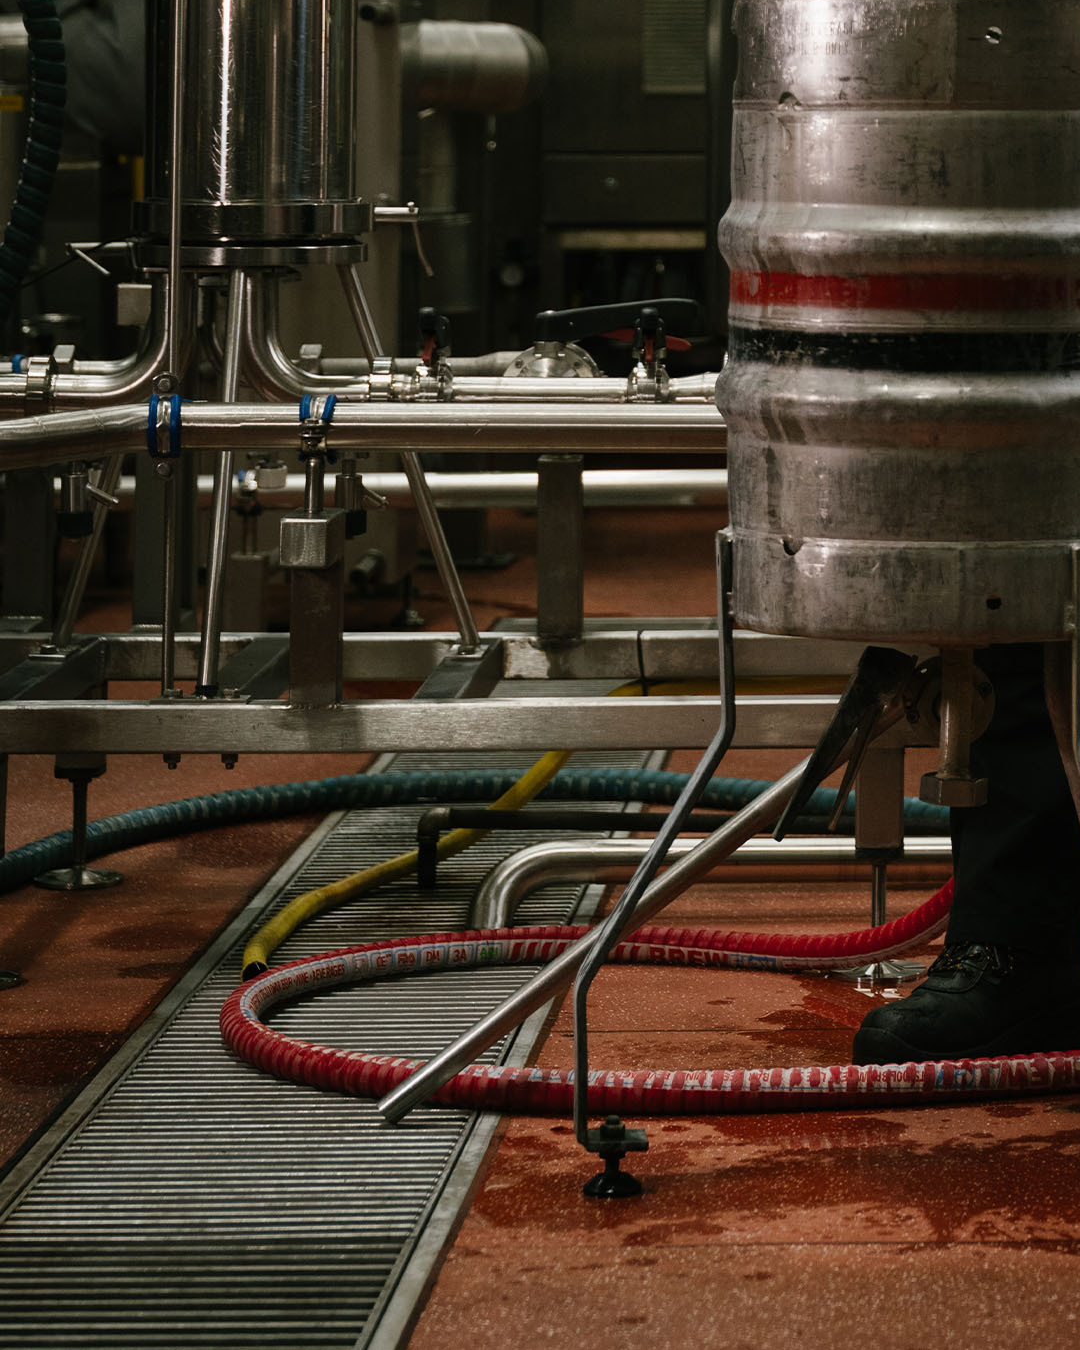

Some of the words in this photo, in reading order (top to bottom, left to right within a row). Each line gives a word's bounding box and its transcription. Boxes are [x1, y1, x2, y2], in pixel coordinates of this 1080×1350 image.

[453, 949, 467, 963] 3A
[650, 947, 729, 966] BREW
[312, 964, 345, 979] BEVERAGES
